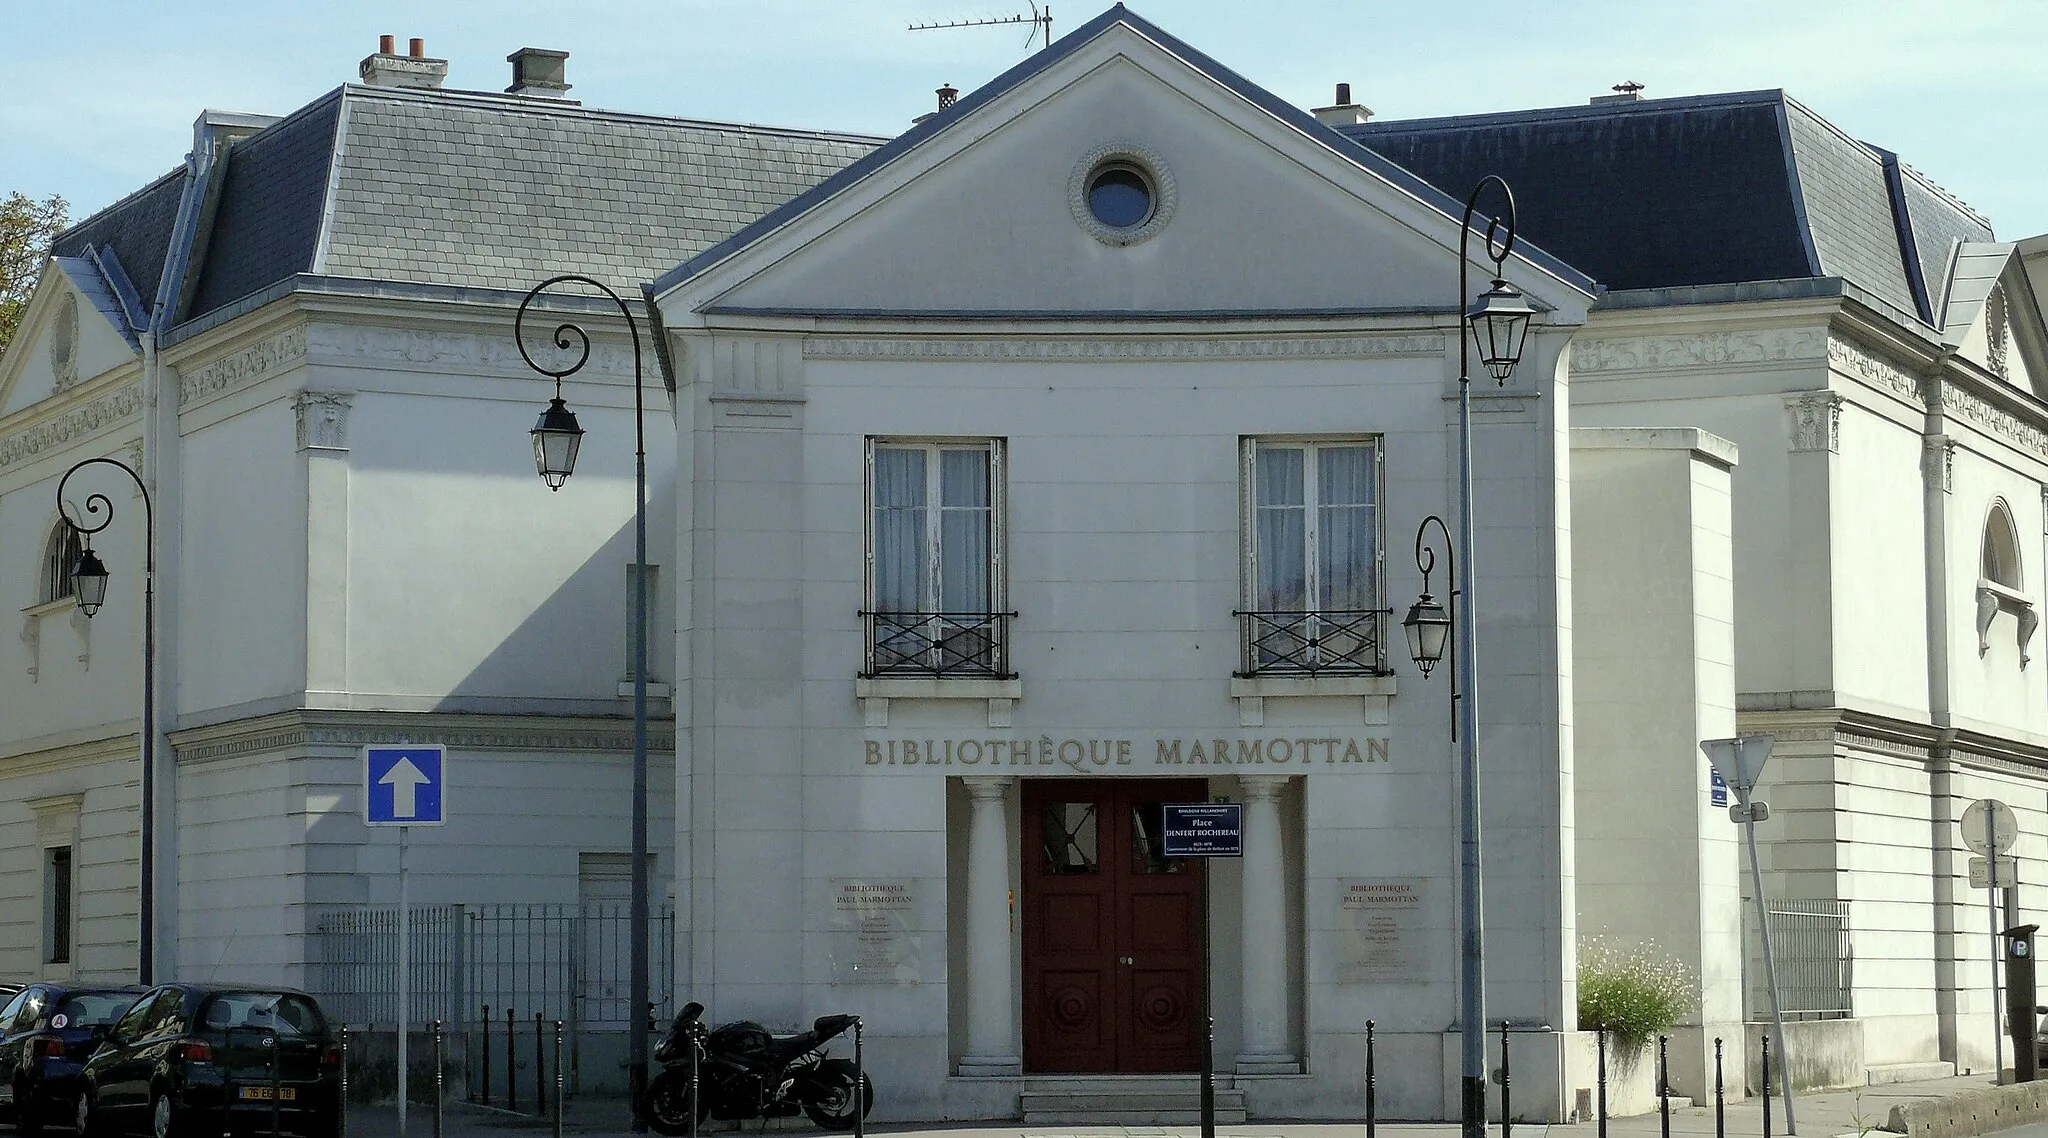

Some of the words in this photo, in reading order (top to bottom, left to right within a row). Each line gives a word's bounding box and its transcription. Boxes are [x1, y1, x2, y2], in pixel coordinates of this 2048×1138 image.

[865, 736, 1131, 773] BIBLIOTHÈQUE
[1155, 738, 1390, 765] MARMOTTAN
[1192, 818, 1213, 827] Place
[1166, 829, 1196, 837] DENFERT
[860, 896, 912, 904] MARMOTTAN
[54, 1015, 63, 1026] A
[280, 1089, 291, 1098] 78
